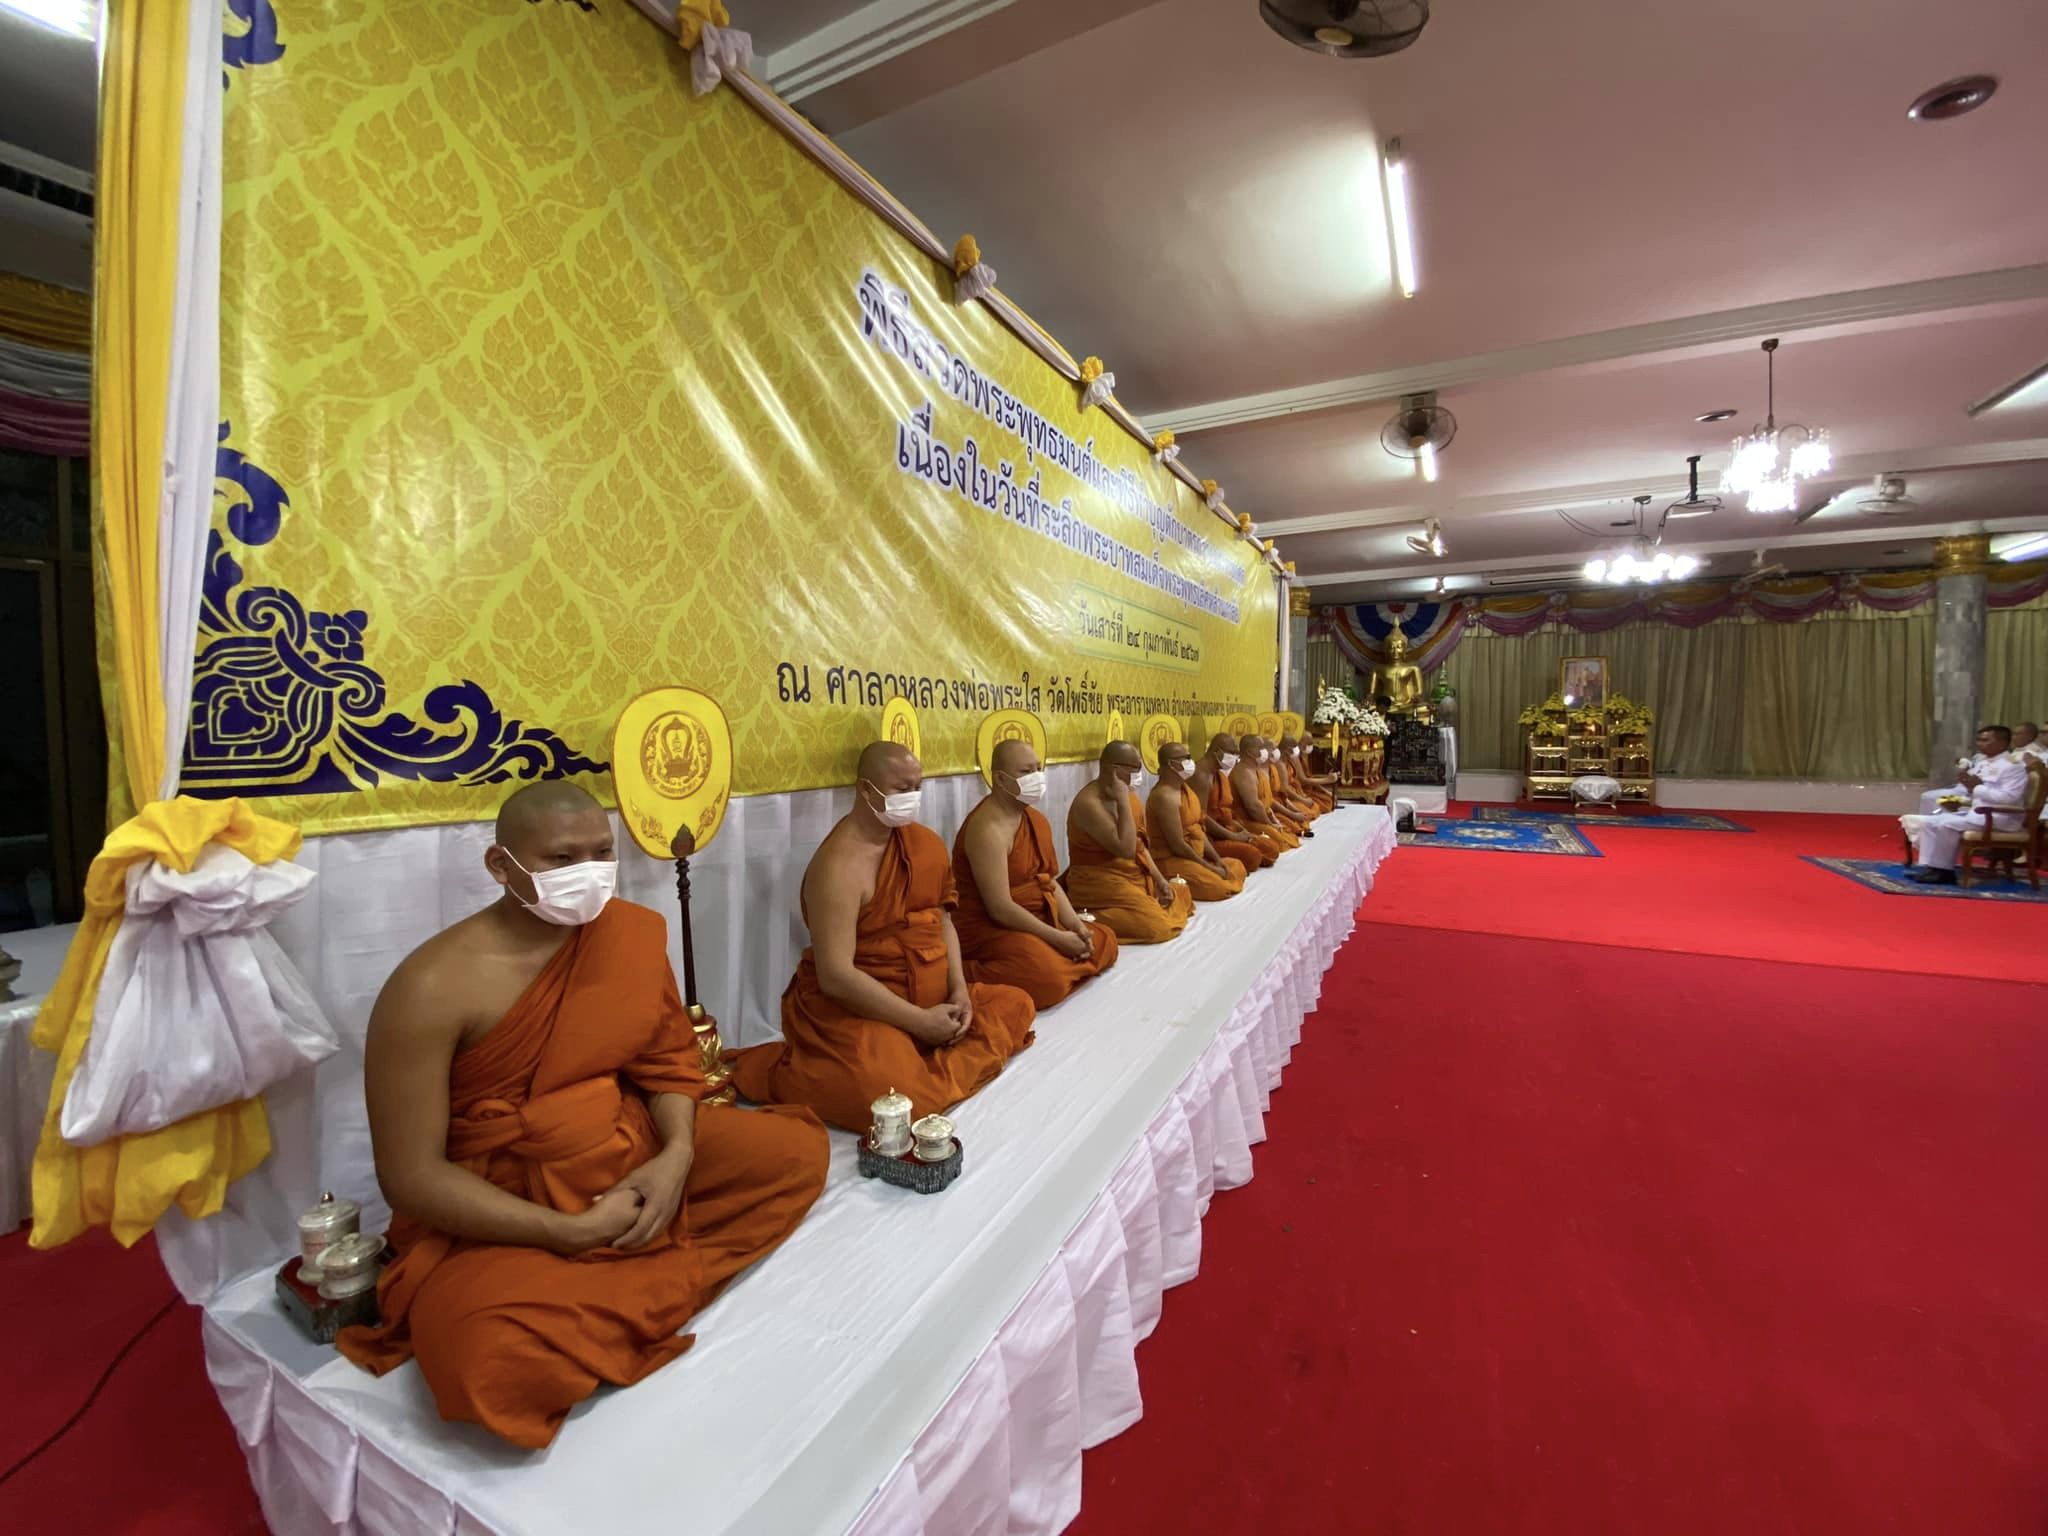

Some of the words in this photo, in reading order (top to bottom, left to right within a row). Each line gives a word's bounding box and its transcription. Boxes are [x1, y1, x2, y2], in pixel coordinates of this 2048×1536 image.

[1079, 600, 1123, 644] วันเสาร์ที่
[1126, 625, 1141, 648] ๒๔
[1143, 628, 1179, 660] กุมภาพันธ์
[776, 662, 811, 703] ณ
[826, 665, 1041, 713] ศาลาหลวงพ่อพระใส
[1047, 670, 1103, 715] วัดโพธิ์ชัย
